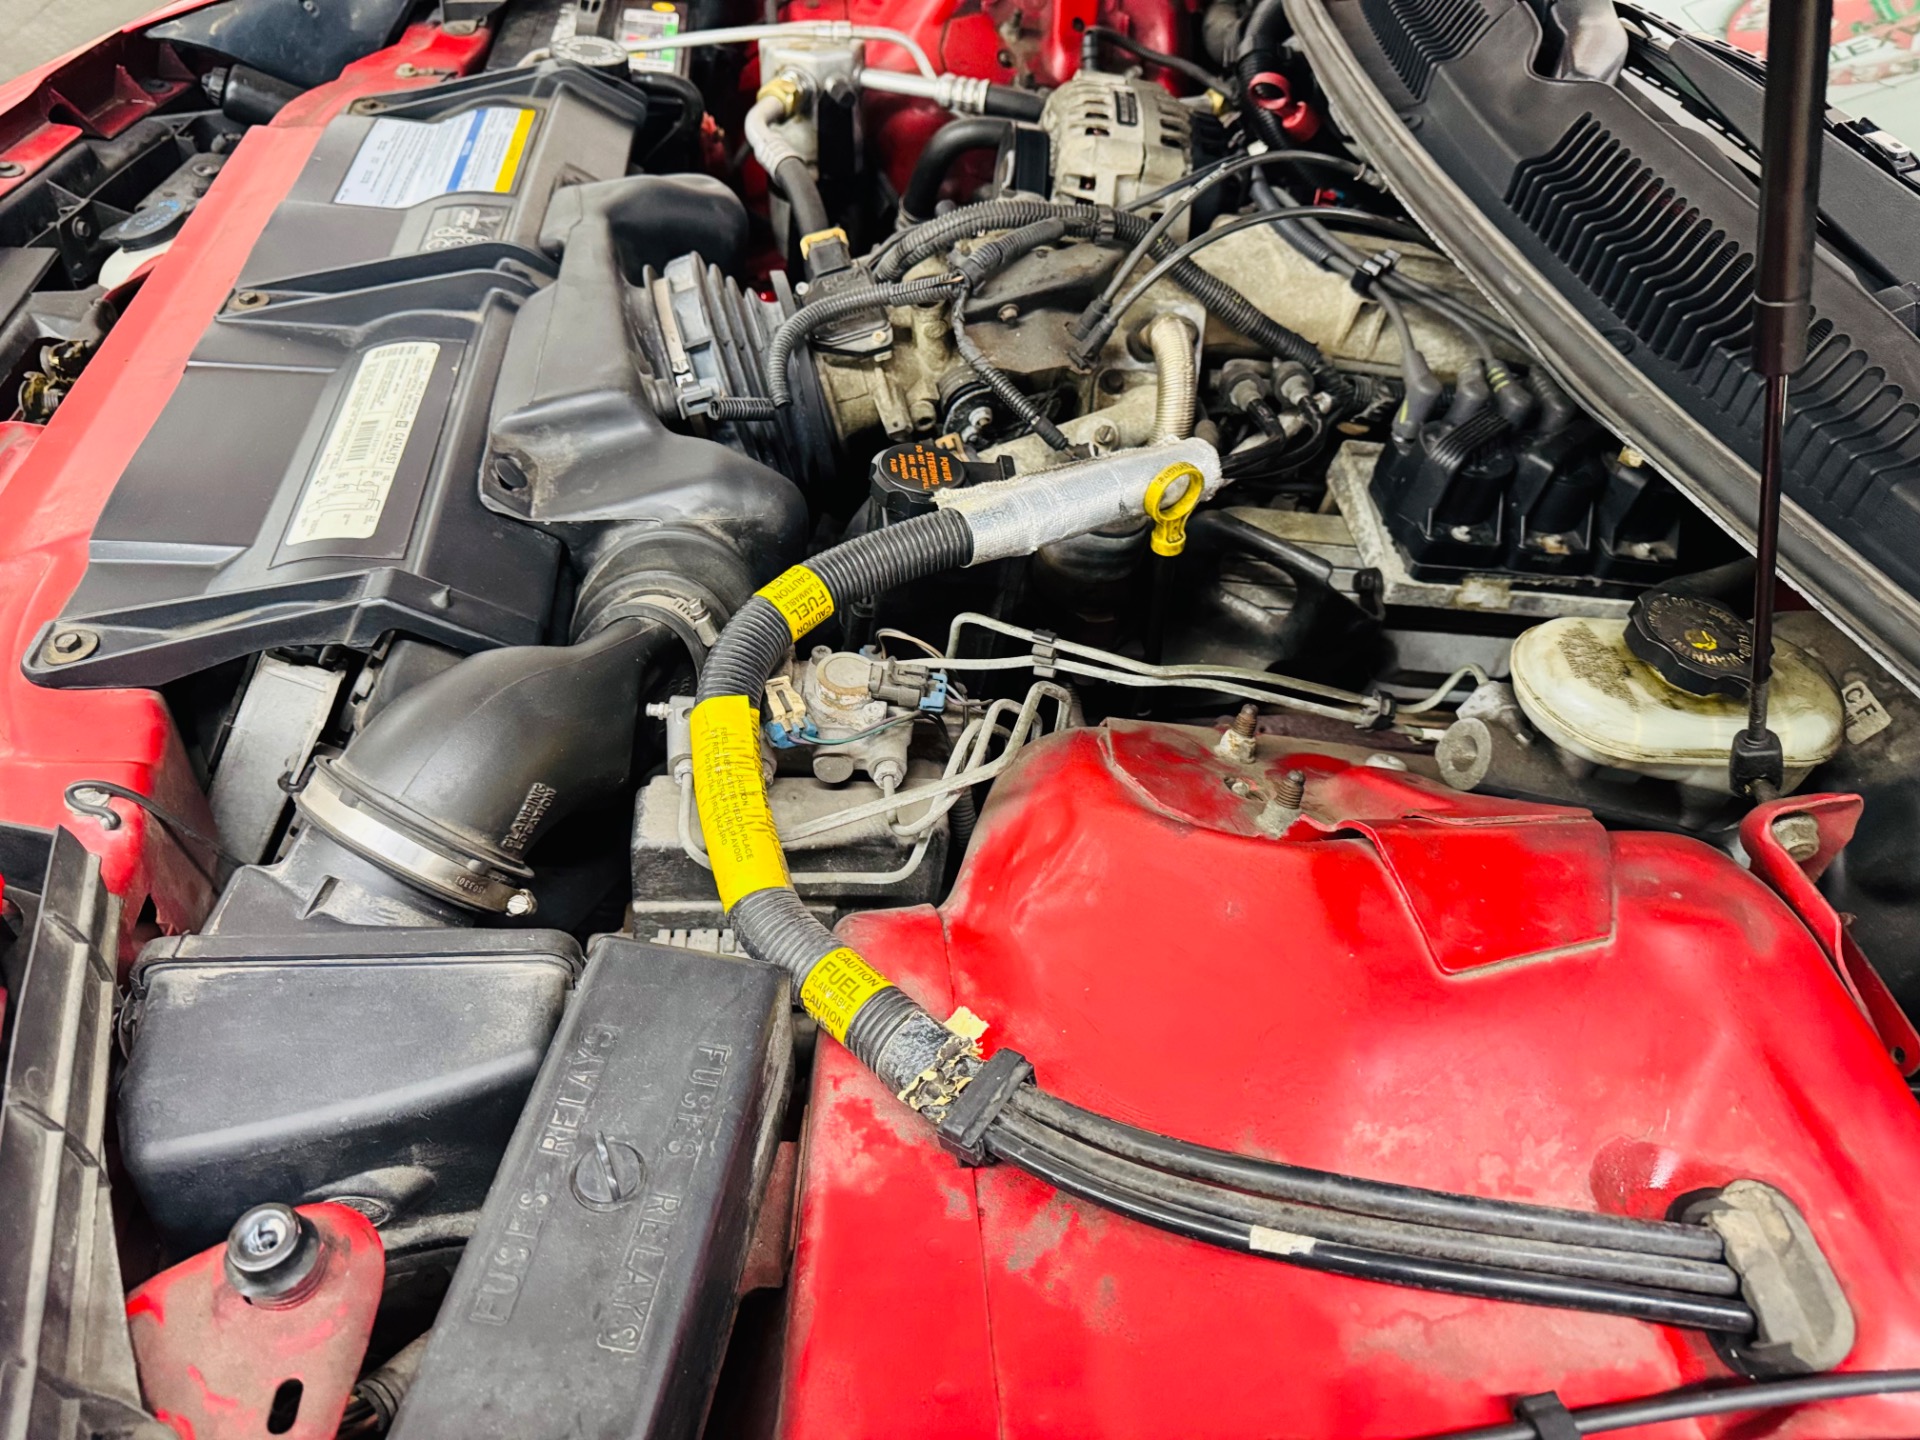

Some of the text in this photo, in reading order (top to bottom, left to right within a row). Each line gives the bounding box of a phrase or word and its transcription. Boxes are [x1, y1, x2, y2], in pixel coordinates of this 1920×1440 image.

[915, 445, 923, 453] DO
[917, 455, 925, 465] NOT
[926, 451, 940, 485] STEERING
[940, 456, 953, 481] POWER
[773, 572, 812, 602] CAUTION
[782, 581, 821, 611] FLAMMABLE
[790, 589, 827, 620] FUEL
[796, 605, 832, 635] CAUTION
[730, 838, 743, 862] AVOID
[740, 833, 753, 859] PLACE
[818, 961, 860, 1003] FUEL
[835, 952, 880, 987] CAUTION
[804, 989, 845, 1029] CAUTION
[810, 974, 853, 1014] FLAMMABLE
[471, 1026, 619, 1323] FUSES RELAYS
[600, 1043, 733, 1349] FUSES RELAYS
